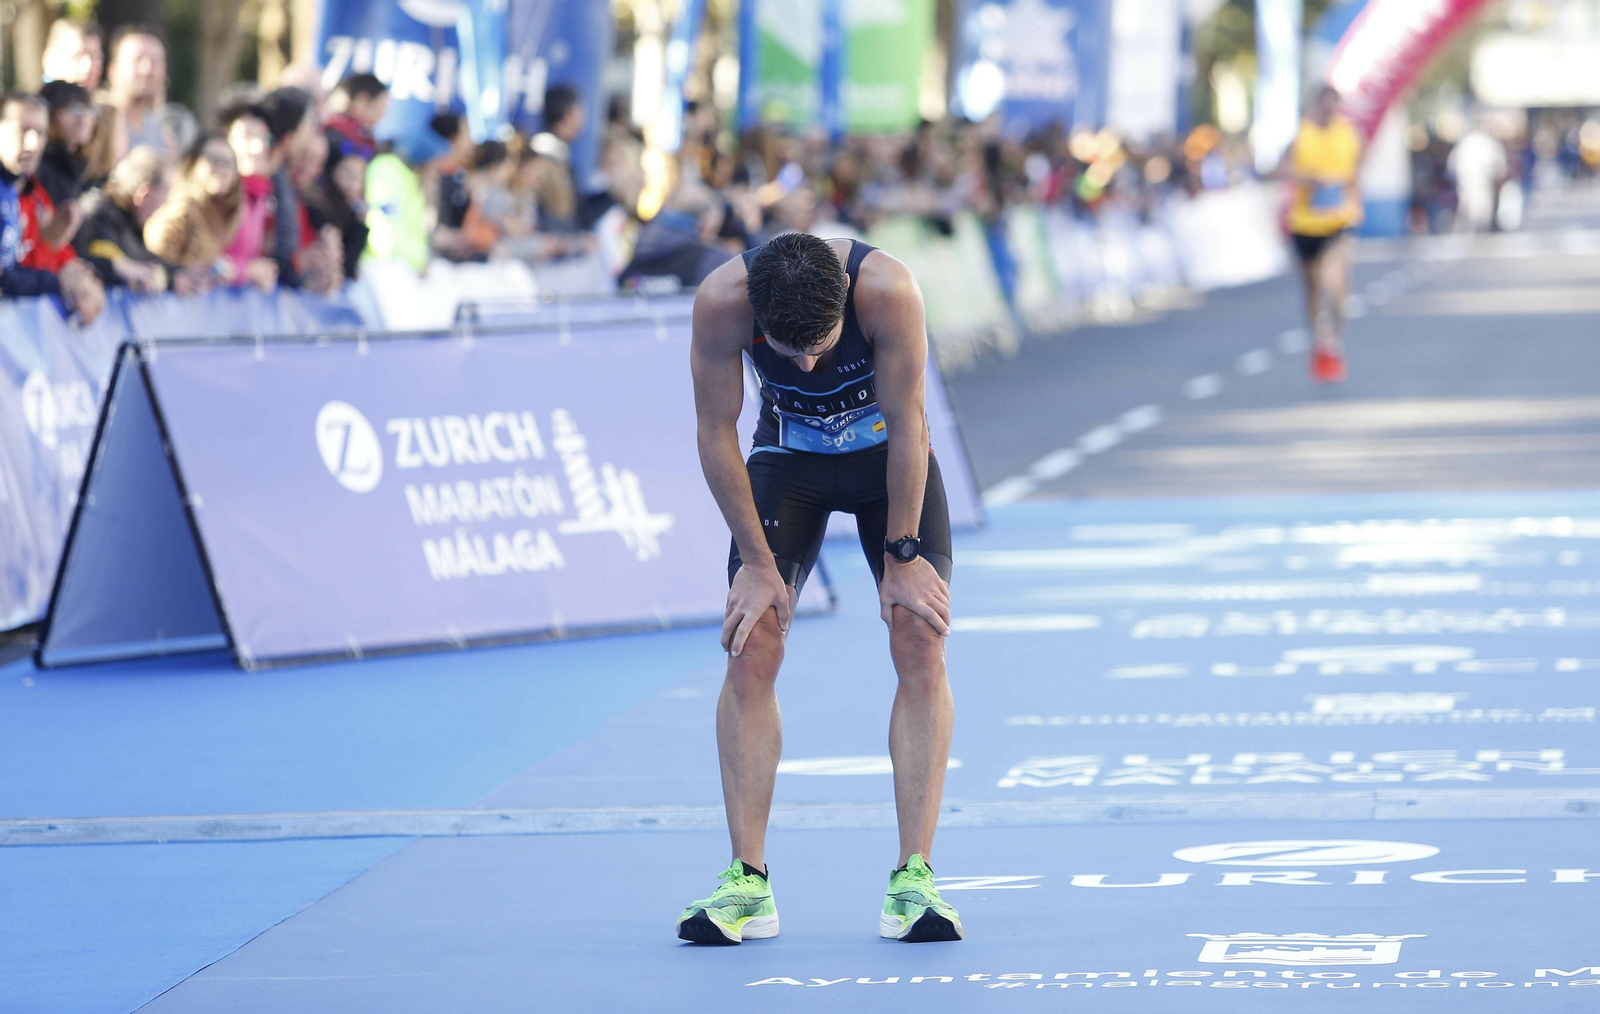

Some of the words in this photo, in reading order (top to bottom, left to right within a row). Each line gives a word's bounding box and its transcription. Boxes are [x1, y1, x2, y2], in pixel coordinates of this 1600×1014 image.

[386, 410, 545, 469] ZURICH
[404, 466, 565, 527] MARATÓN
[422, 526, 566, 581] MÁLAGA
[745, 968, 1357, 987] Ayuntamiento
[1394, 969, 1498, 979] de
